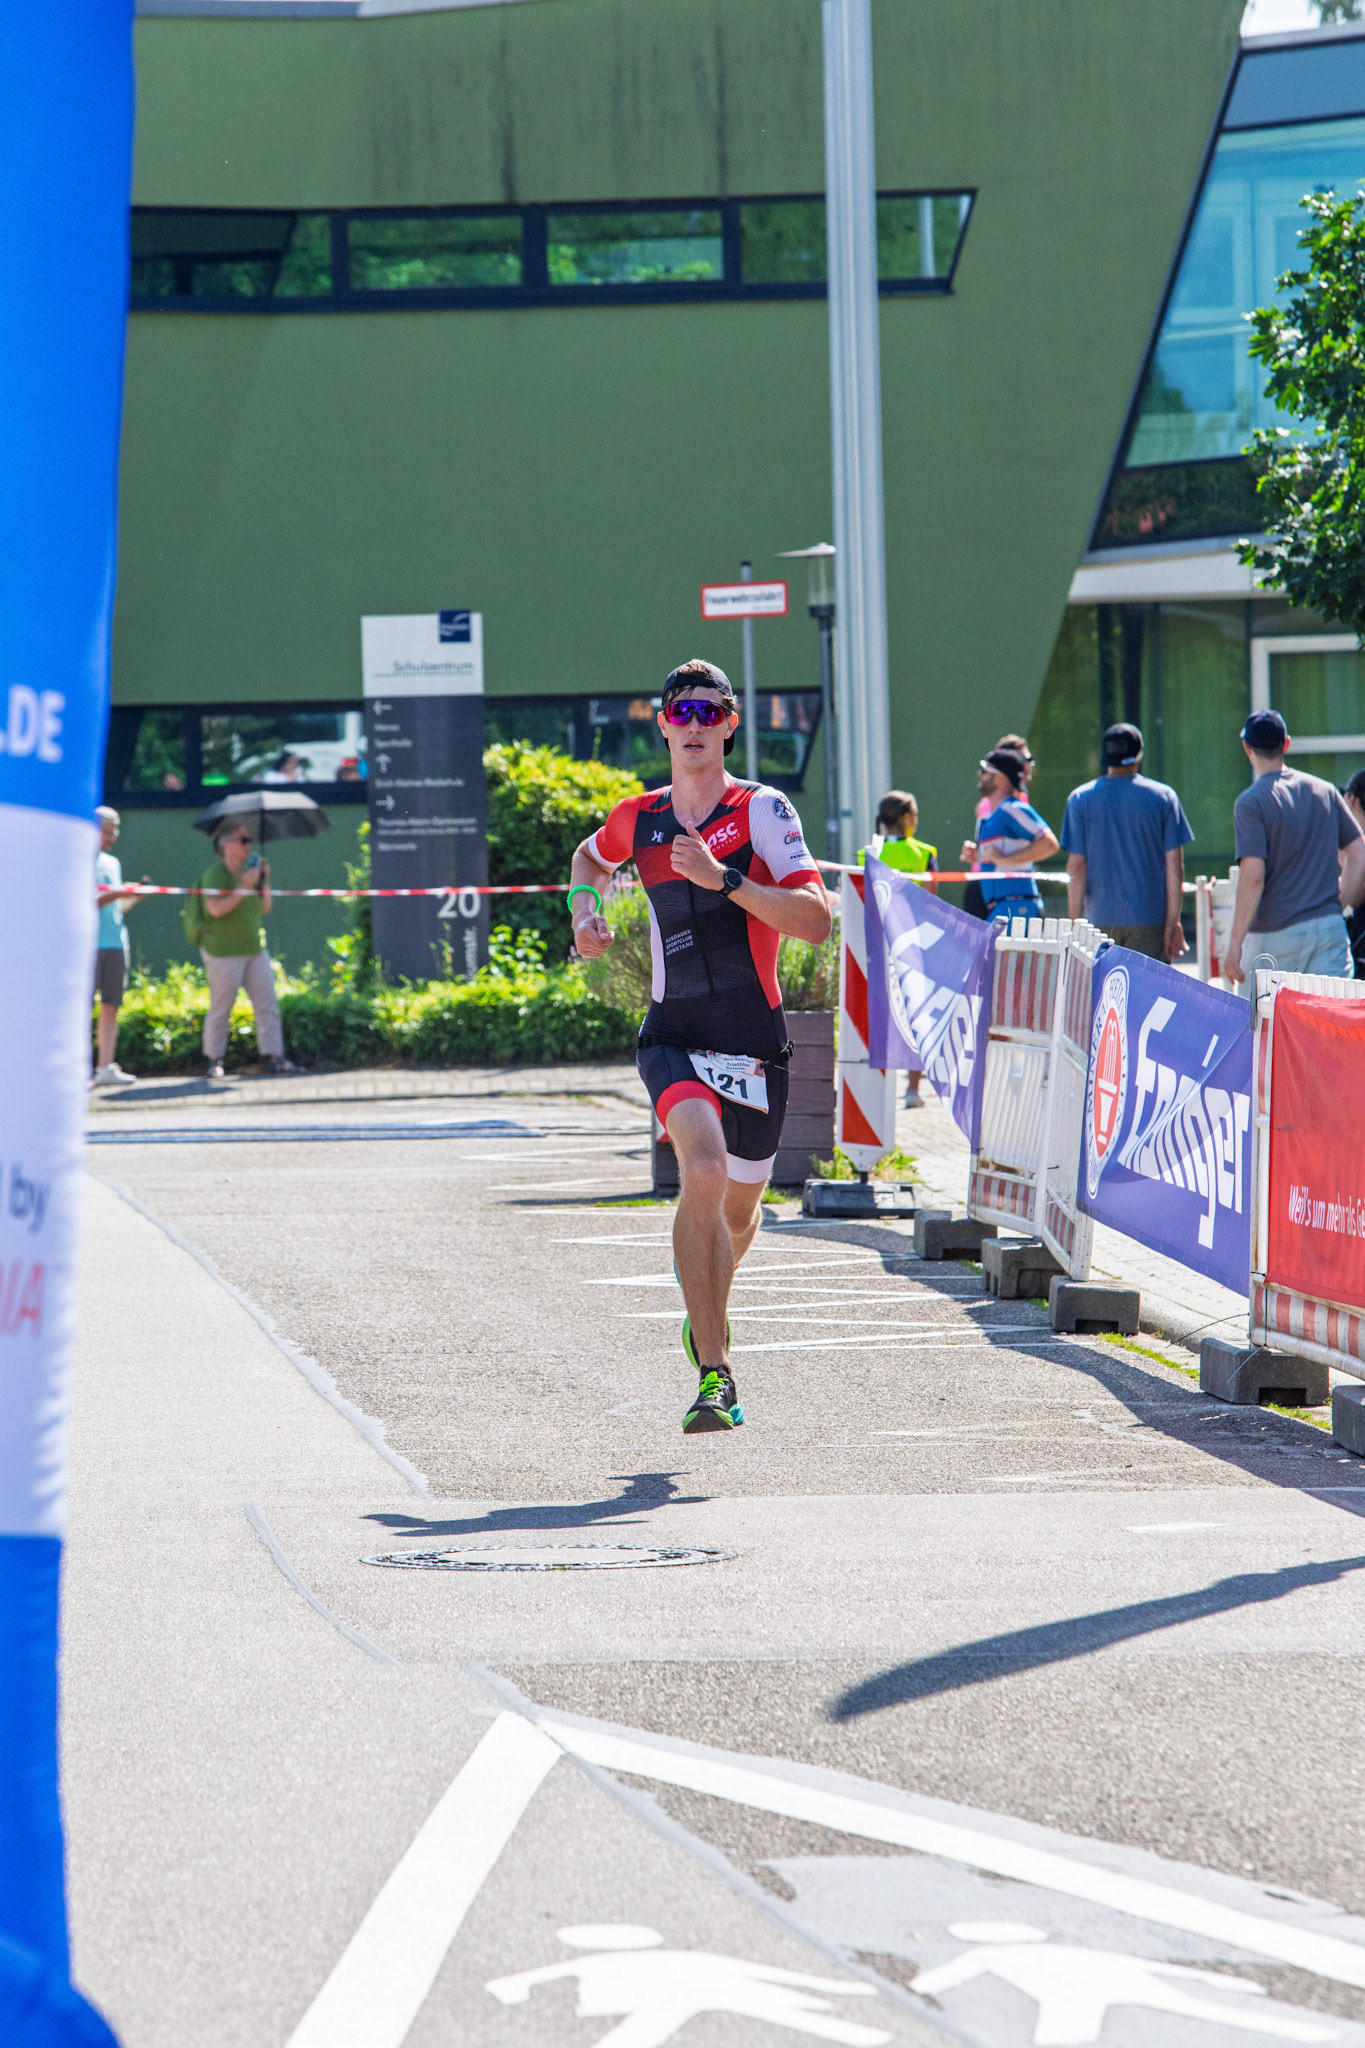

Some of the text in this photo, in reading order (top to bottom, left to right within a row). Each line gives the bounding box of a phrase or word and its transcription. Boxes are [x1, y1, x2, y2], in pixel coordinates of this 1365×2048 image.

[706, 822, 738, 849] ASC
[710, 833, 741, 853] ONSTANZ
[437, 886, 482, 919] 20
[703, 1067, 748, 1100] 121
[9, 1160, 50, 1235] by
